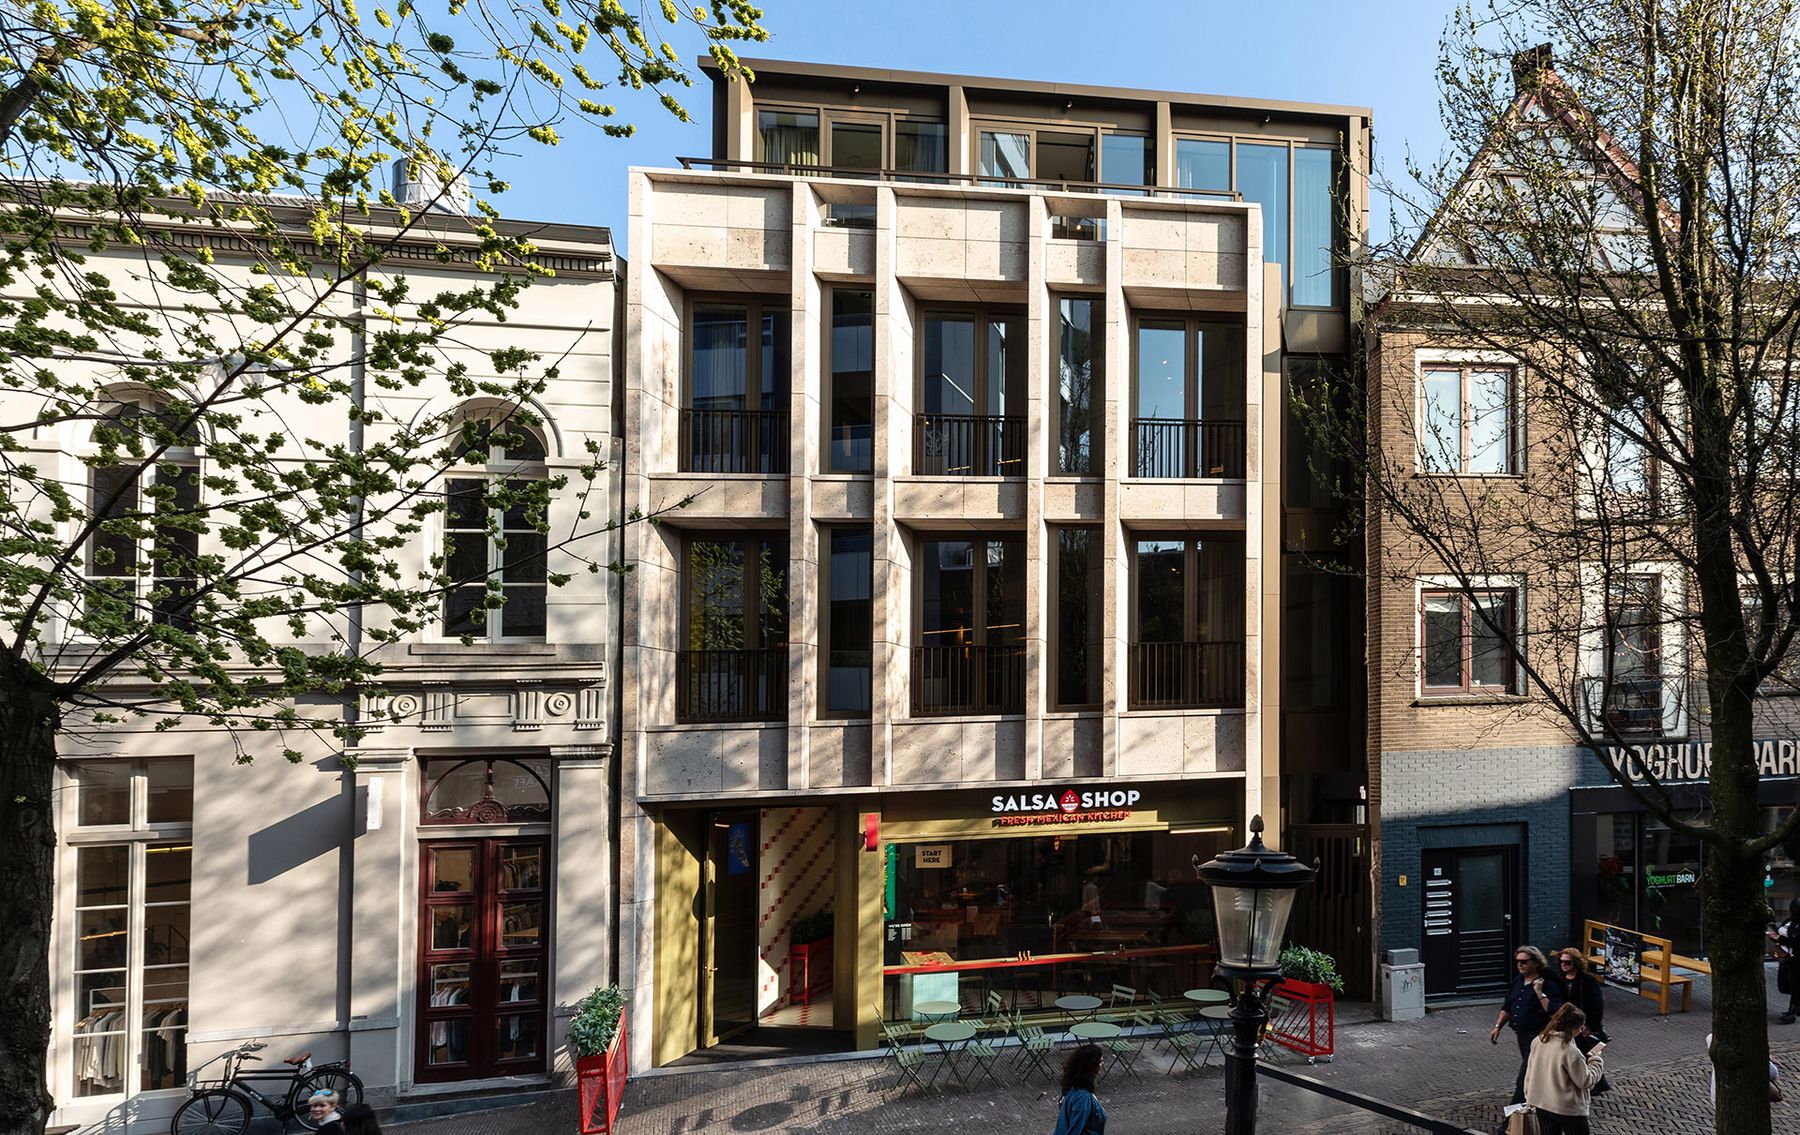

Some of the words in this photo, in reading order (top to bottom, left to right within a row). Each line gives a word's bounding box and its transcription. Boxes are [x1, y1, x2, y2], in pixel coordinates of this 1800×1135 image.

[1608, 743, 1713, 782] YOGHU
[991, 794, 1059, 812] SALSA
[1081, 790, 1141, 808] SHOP
[1000, 815, 1034, 825] FRESH
[1037, 813, 1085, 824] MEXICAN
[1087, 810, 1132, 821] KITCHEN
[1647, 875, 1677, 886] YOGHURT
[1676, 873, 1695, 884] BARN
